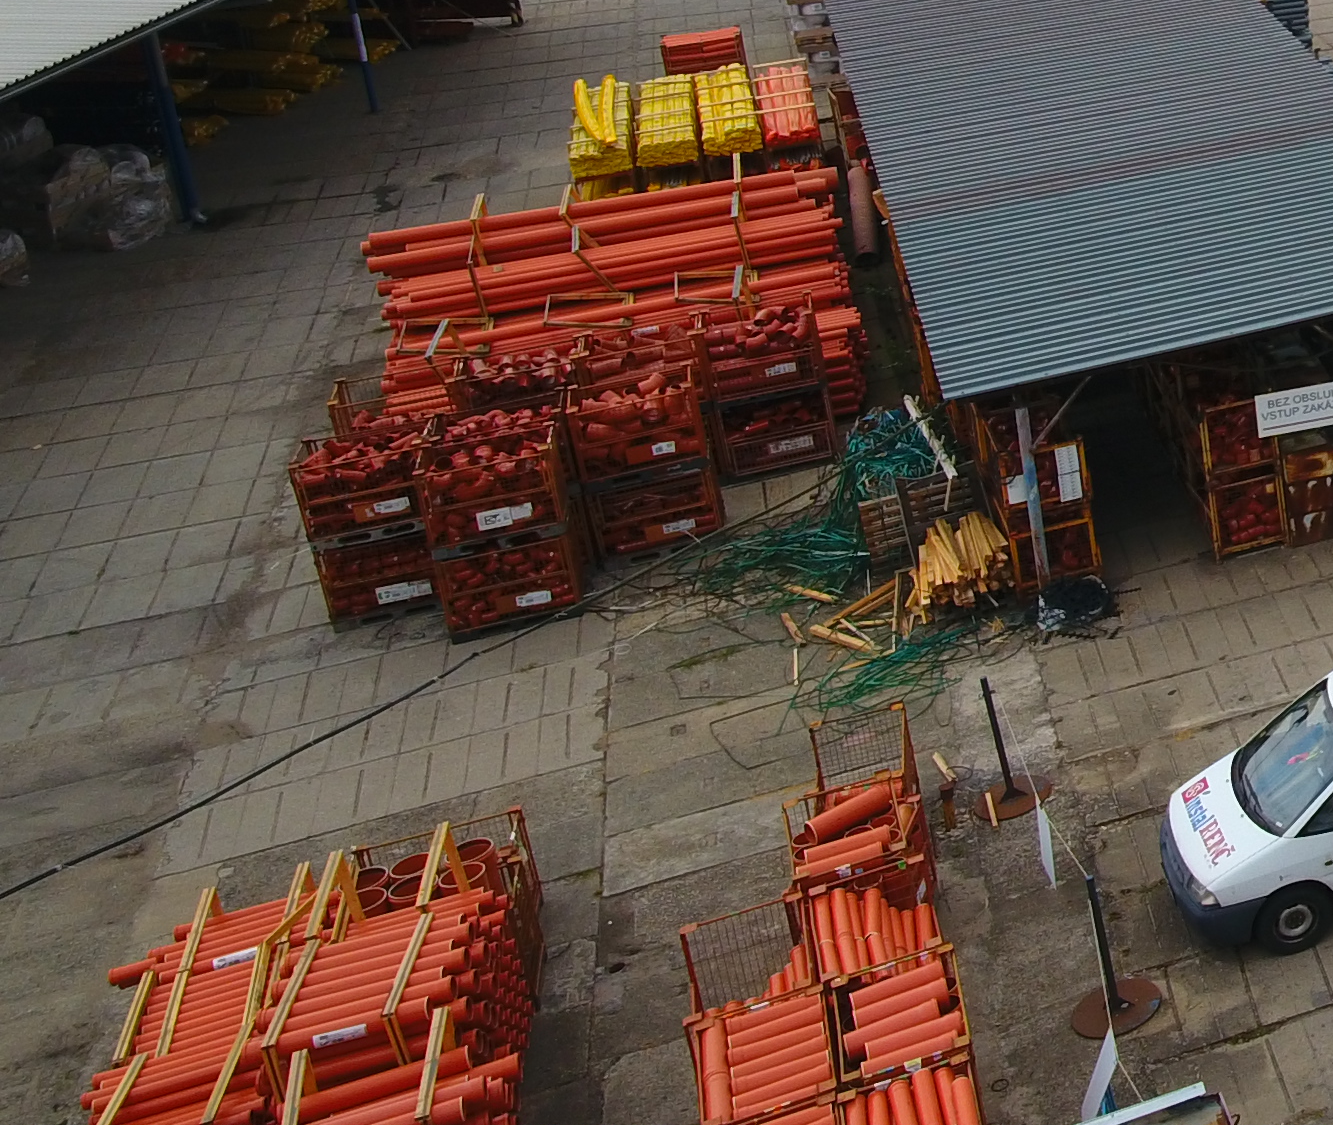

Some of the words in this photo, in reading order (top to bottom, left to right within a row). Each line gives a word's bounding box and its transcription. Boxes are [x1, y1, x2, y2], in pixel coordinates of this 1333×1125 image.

[1267, 395, 1290, 409] BEZ
[1261, 406, 1300, 422] VSTUP
[1199, 818, 1236, 866] RENČ
